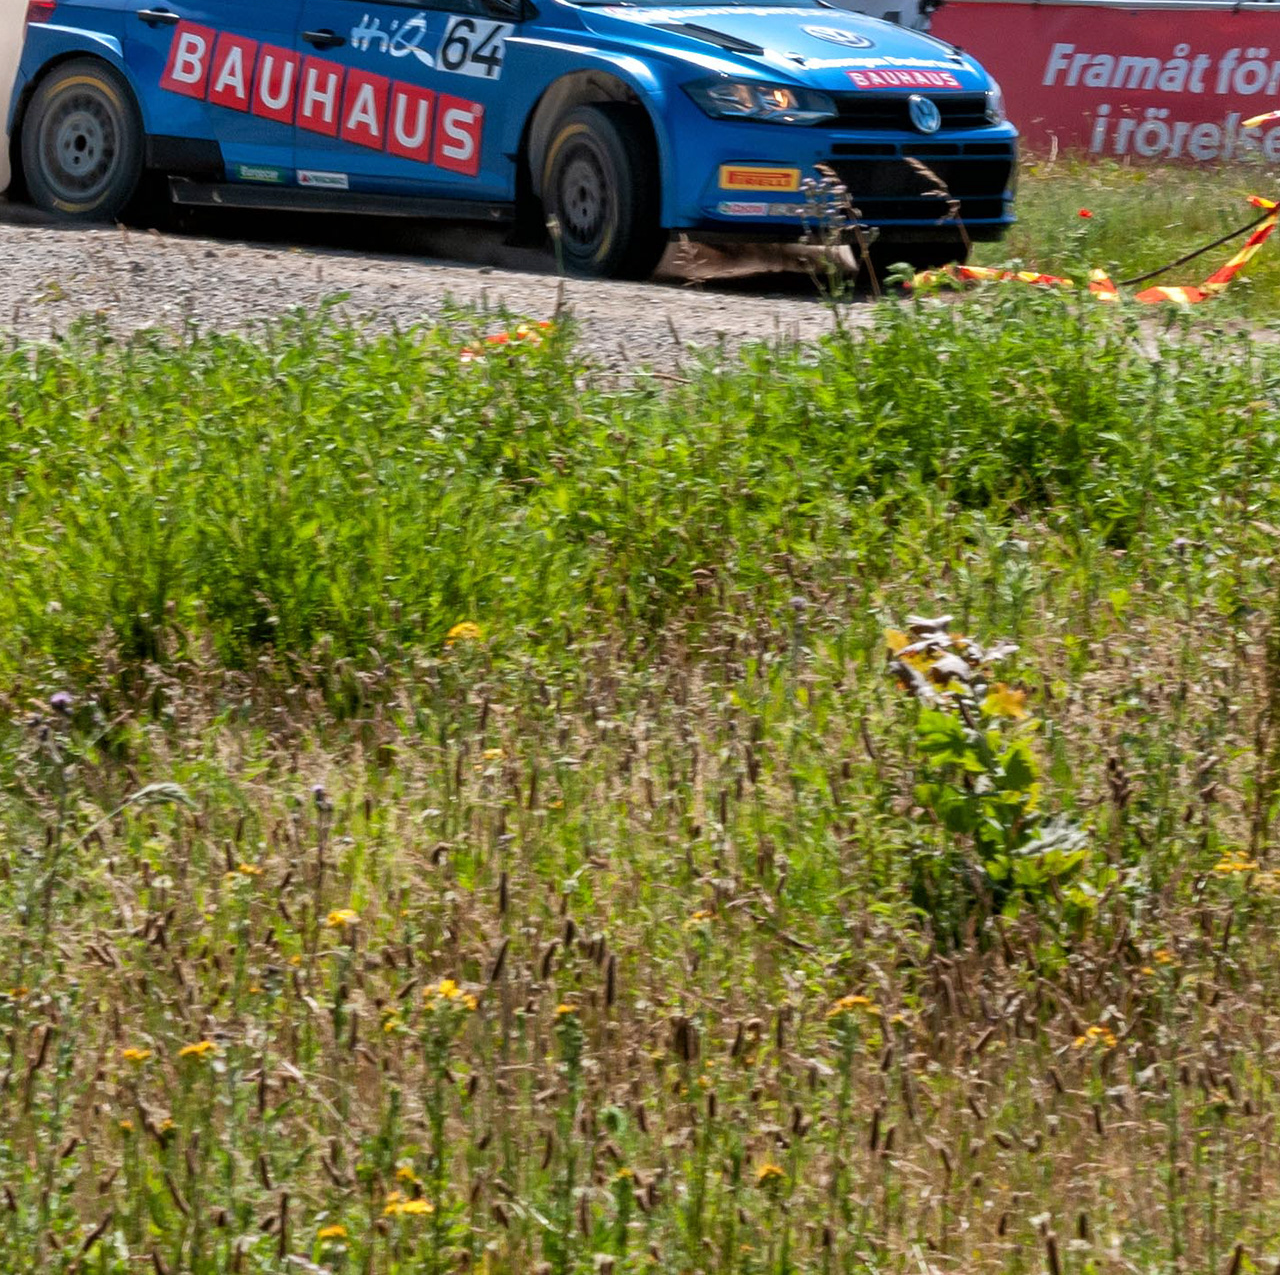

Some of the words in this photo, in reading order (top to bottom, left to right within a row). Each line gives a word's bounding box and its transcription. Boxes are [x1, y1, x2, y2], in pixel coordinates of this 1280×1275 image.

[441, 19, 504, 76] 64
[1042, 43, 1212, 93] Framåt
[171, 31, 475, 161] BAUHAUS
[851, 70, 960, 88] BAUHAUS
[1089, 103, 1112, 154] i
